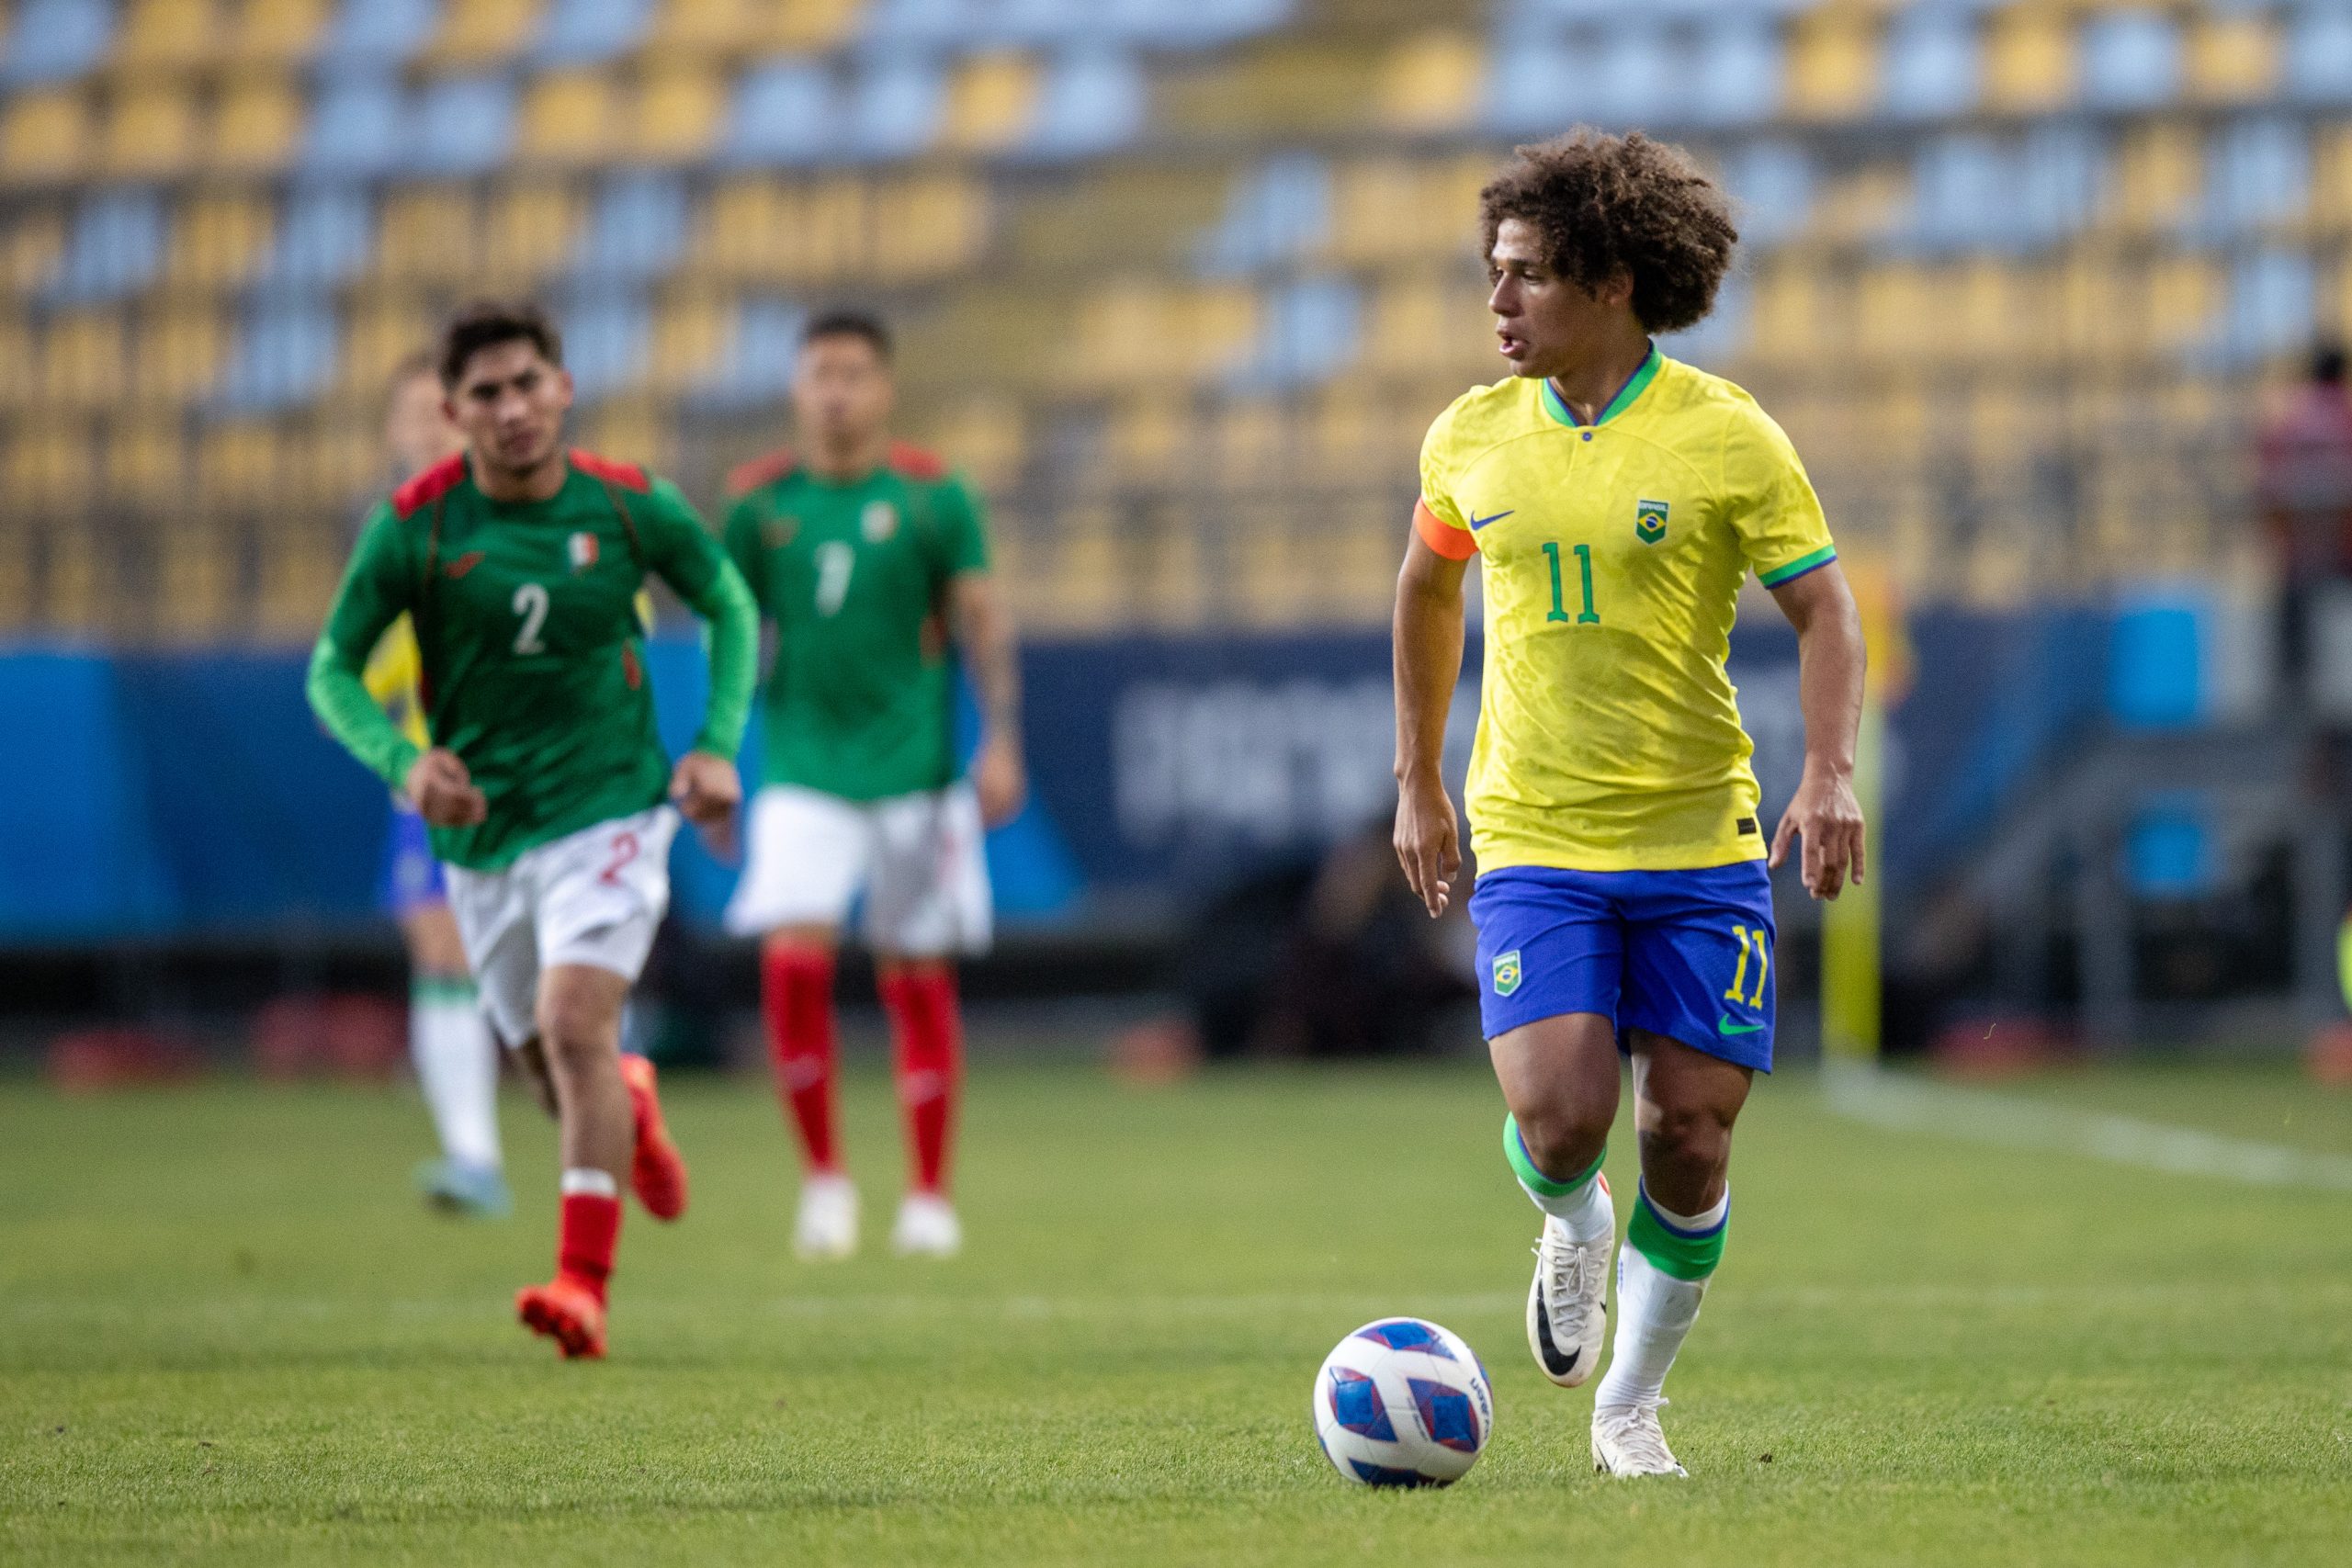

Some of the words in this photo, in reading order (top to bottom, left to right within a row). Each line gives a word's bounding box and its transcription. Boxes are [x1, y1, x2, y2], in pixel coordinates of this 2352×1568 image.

[512, 583, 549, 653] 2
[1542, 542, 1600, 624] 11
[599, 831, 639, 886] 2
[1724, 926, 1768, 1010] 11
